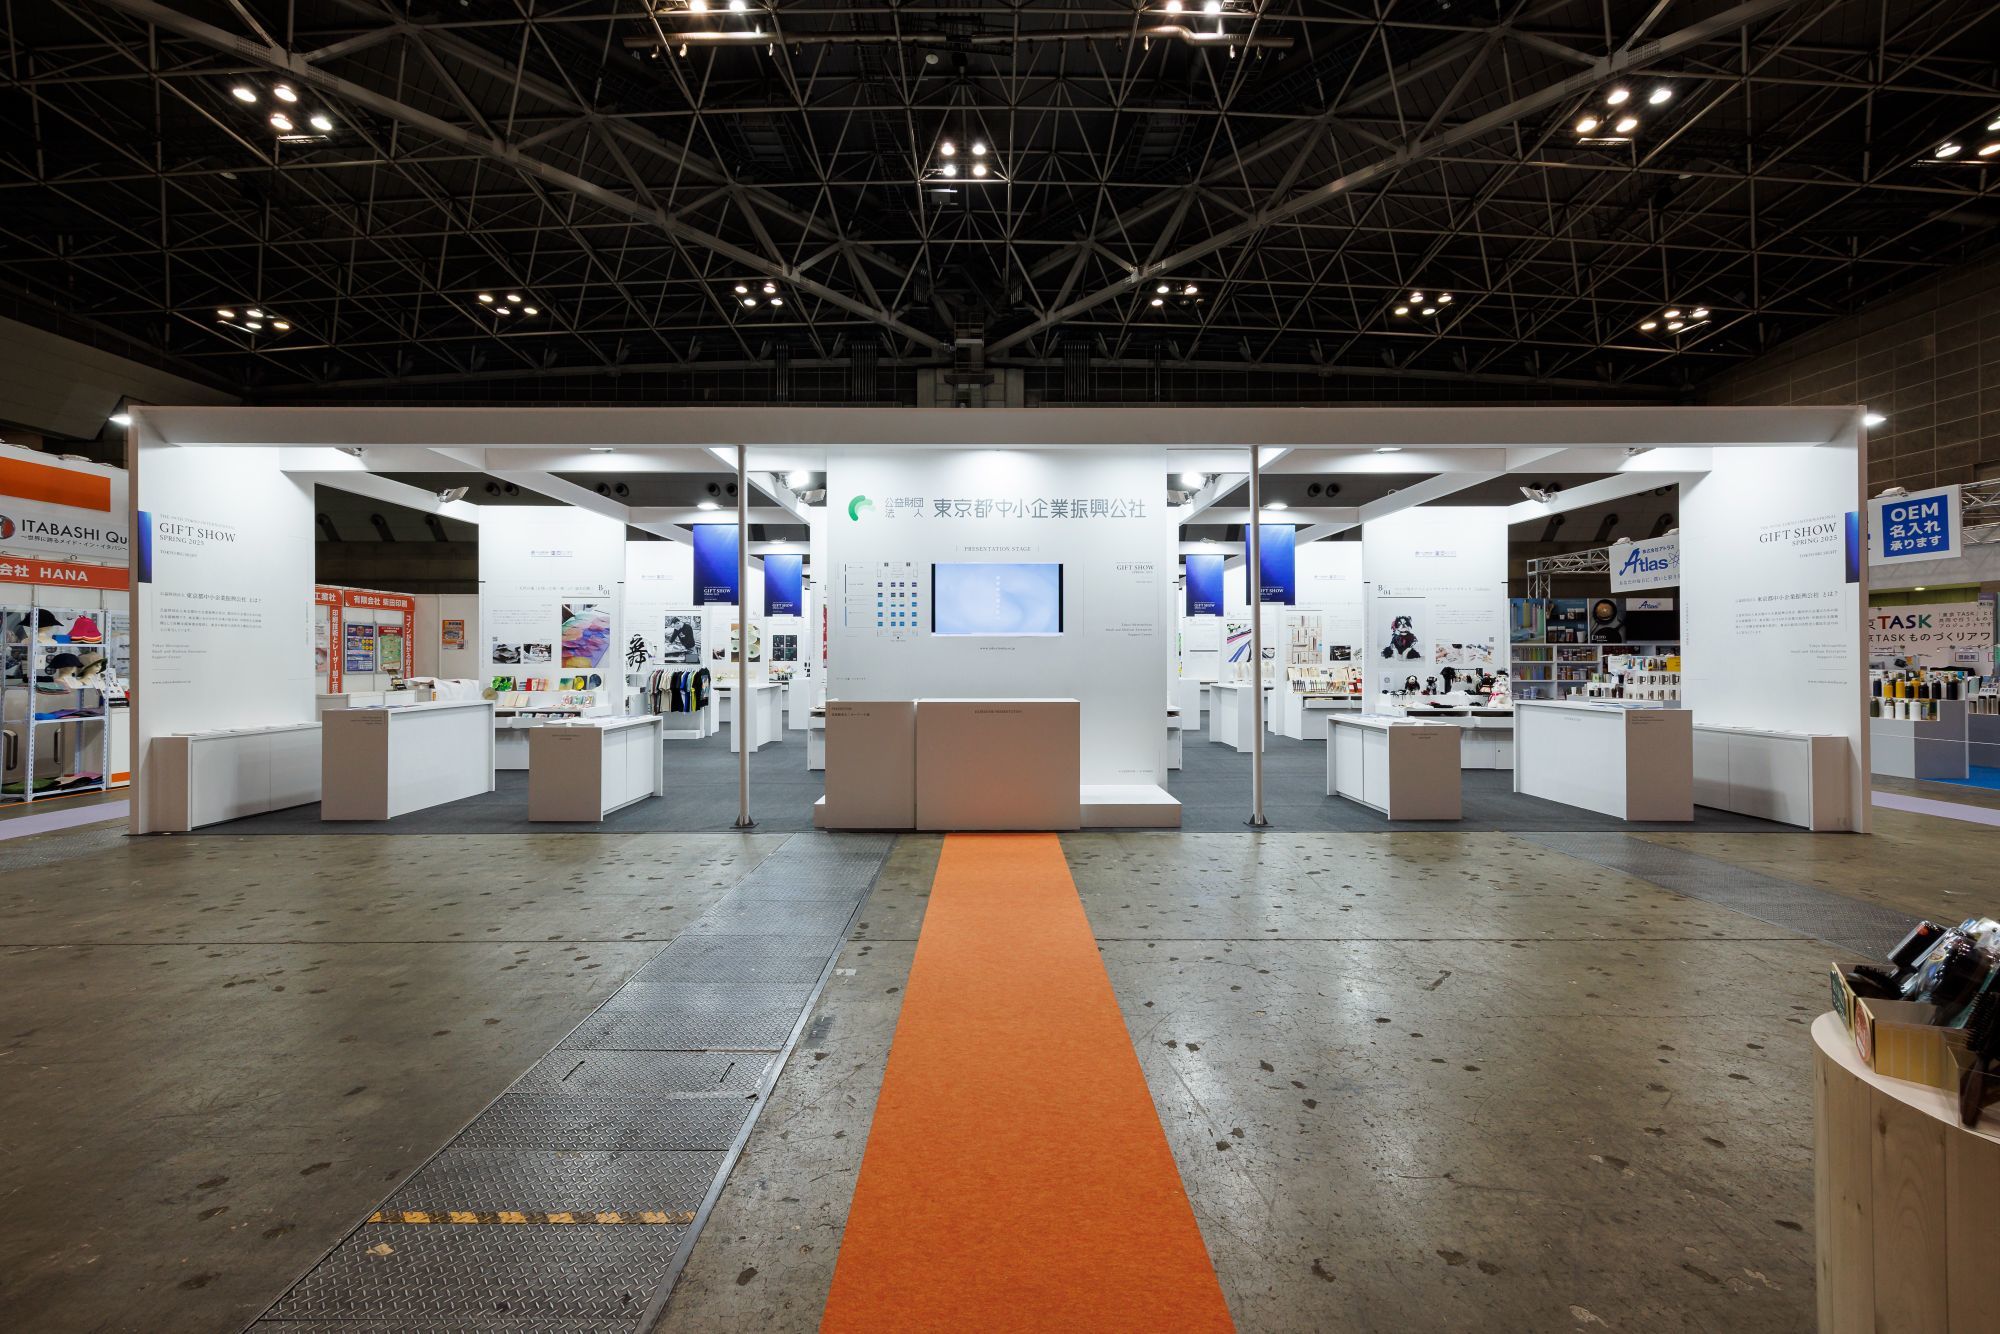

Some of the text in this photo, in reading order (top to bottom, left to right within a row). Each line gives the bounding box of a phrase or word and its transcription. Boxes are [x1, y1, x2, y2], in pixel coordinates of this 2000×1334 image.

[885, 497, 924, 507] 公益財団
[932, 497, 1147, 519] 東京都中小企業振興公社
[1890, 502, 1939, 522] OEM
[21, 519, 100, 541] ITABASHI
[159, 534, 187, 544] SPRING
[160, 522, 195, 537] GIFT
[197, 528, 236, 543] SHOW
[1759, 529, 1791, 544] GIFT
[1793, 522, 1837, 539] SHOW
[1889, 520, 1941, 539] 名入れ
[1792, 535, 1838, 547] SPRING 2025
[1890, 535, 1942, 551] 承ります
[1619, 547, 1669, 577] Atlas
[40, 567, 88, 582] HANA
[354, 595, 381, 606] 有限会社
